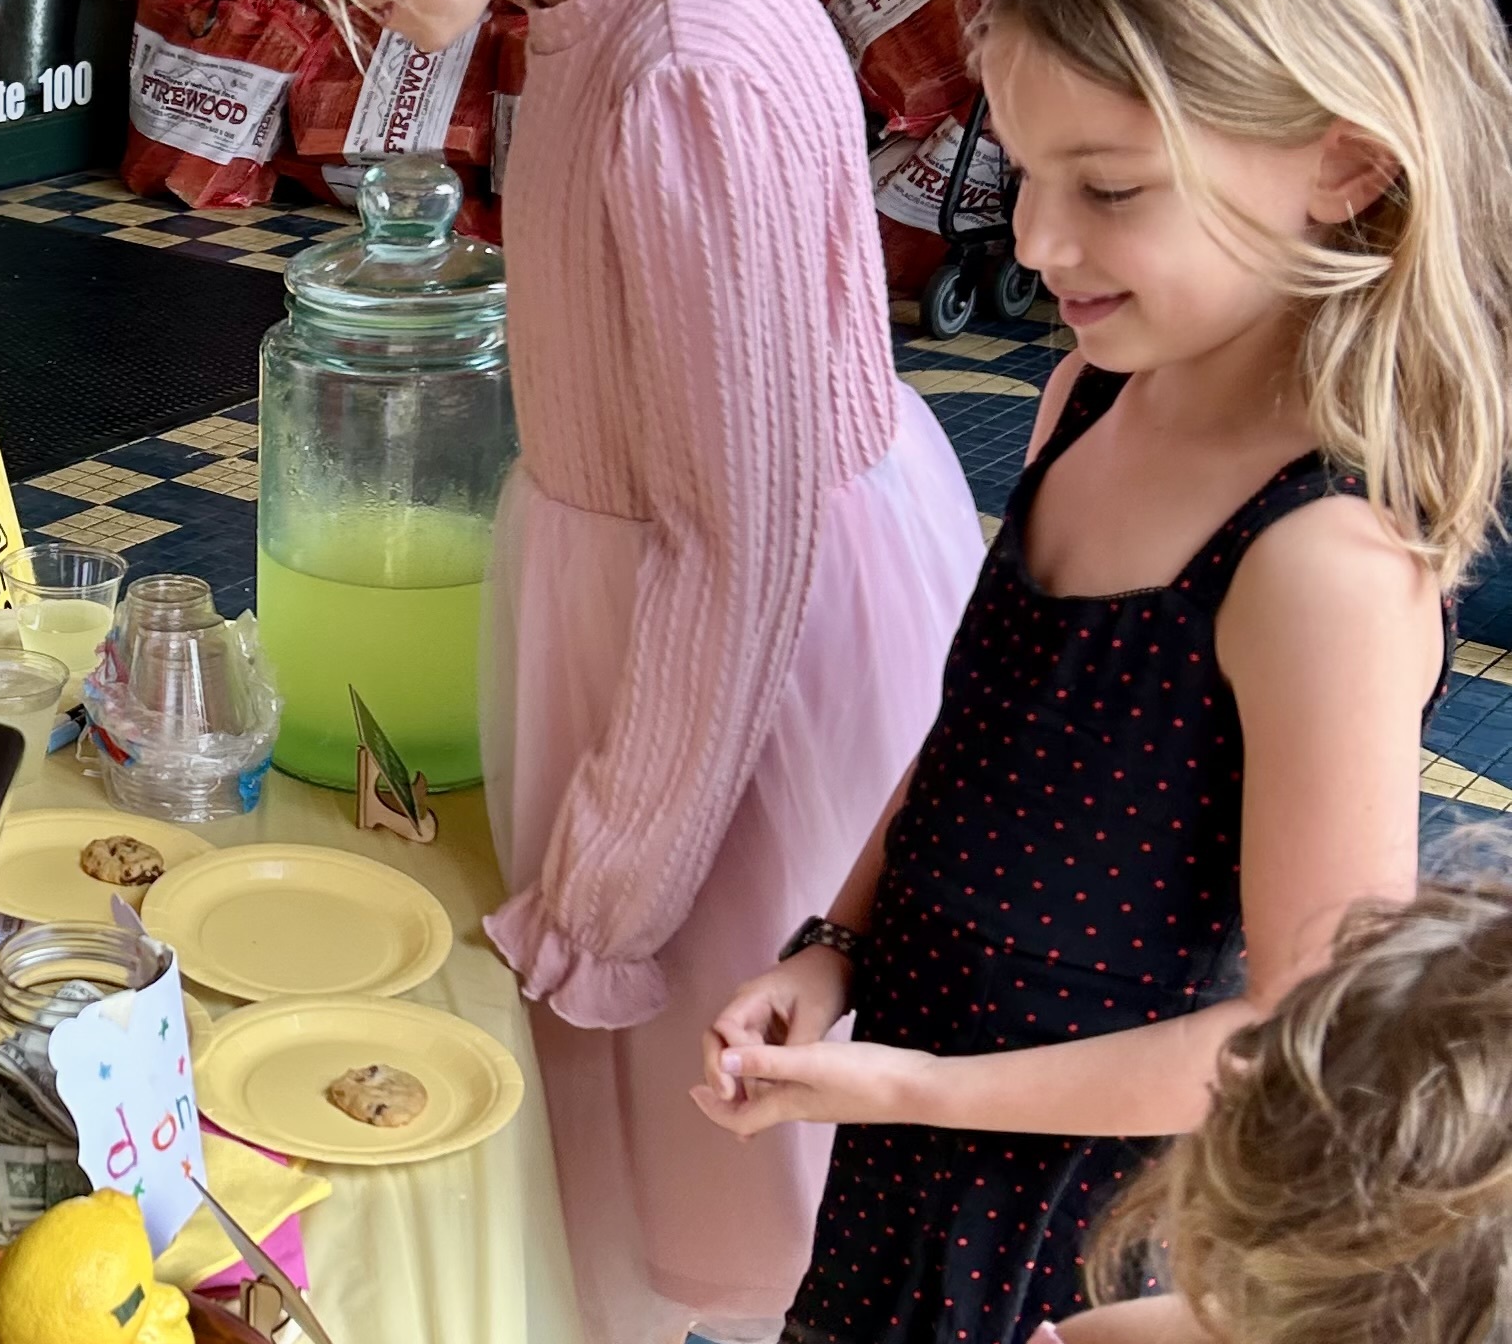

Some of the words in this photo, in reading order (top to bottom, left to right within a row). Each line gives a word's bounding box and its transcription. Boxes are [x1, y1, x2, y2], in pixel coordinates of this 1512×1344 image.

[39, 60, 93, 115] 100
[140, 74, 248, 125] FIREWOOD
[383, 41, 431, 154] FIREWO
[106, 1102, 193, 1181] don
